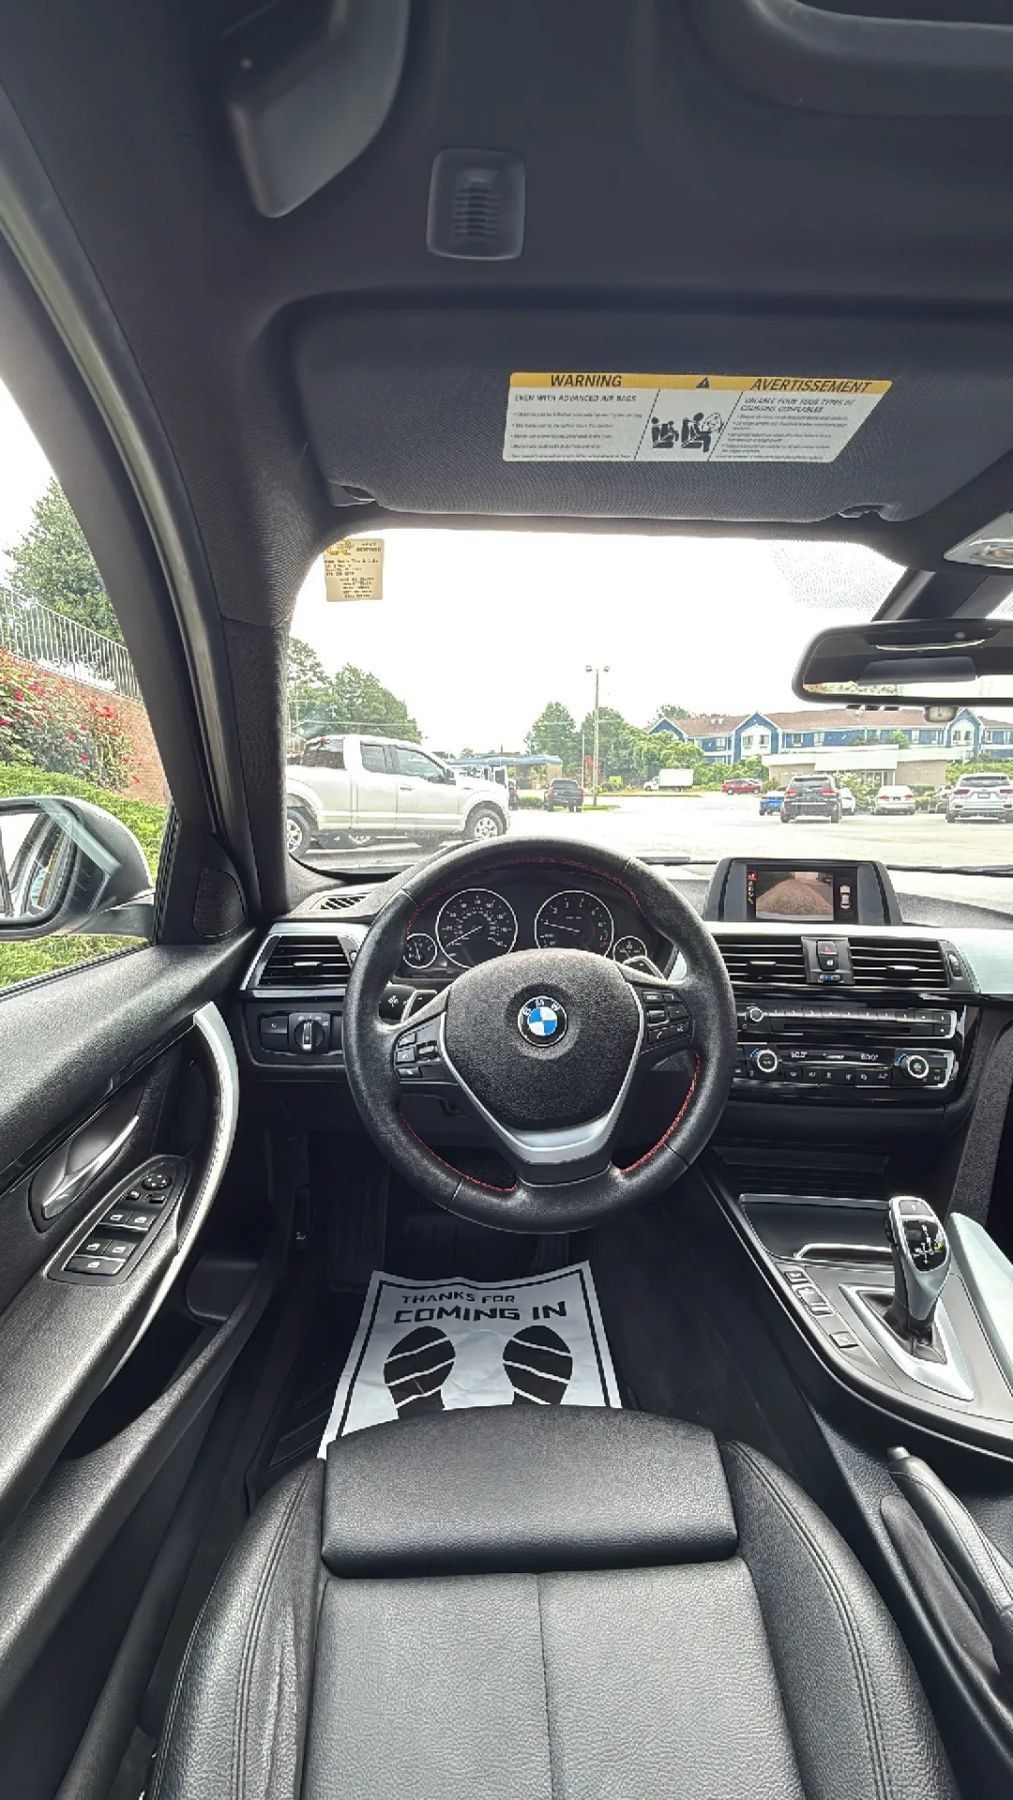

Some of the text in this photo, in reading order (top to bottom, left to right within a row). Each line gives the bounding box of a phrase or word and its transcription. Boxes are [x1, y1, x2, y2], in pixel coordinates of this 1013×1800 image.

[550, 374, 622, 387] WARNING
[749, 378, 872, 393] AVERTISSEMENT
[401, 1291, 516, 1304] THANKS FOR
[394, 1301, 568, 1324] COMING IN
